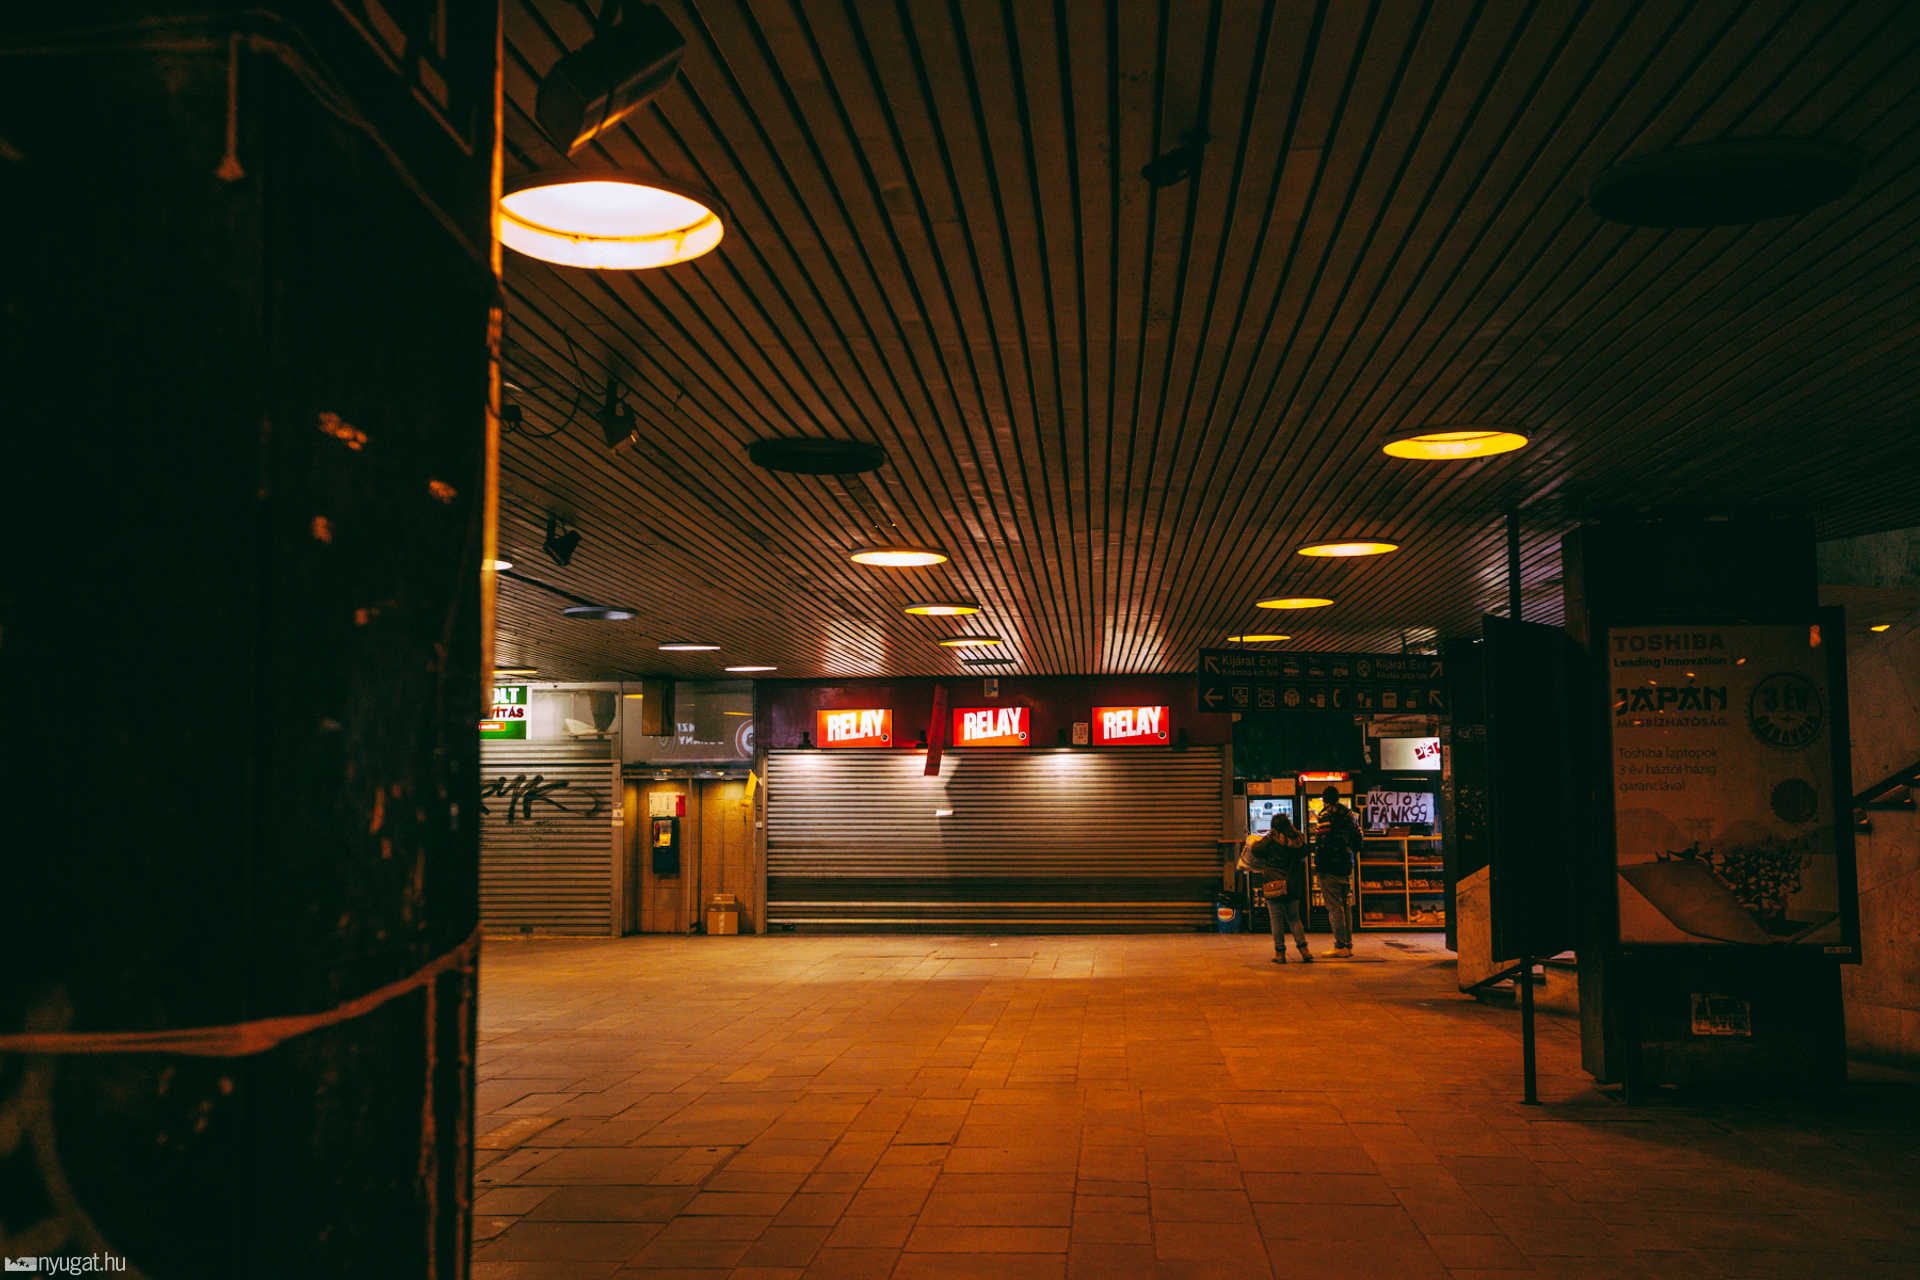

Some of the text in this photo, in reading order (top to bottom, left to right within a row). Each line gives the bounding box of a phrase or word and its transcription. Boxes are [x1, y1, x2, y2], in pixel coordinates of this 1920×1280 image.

[1613, 633, 1725, 651] TOSHIBA
[1614, 656, 1727, 668] Leading Innovation
[828, 708, 884, 742] RELAY
[964, 707, 1022, 740] RELAY
[1102, 707, 1162, 740] RELAY
[1619, 747, 1718, 761] Toshiba laptopok
